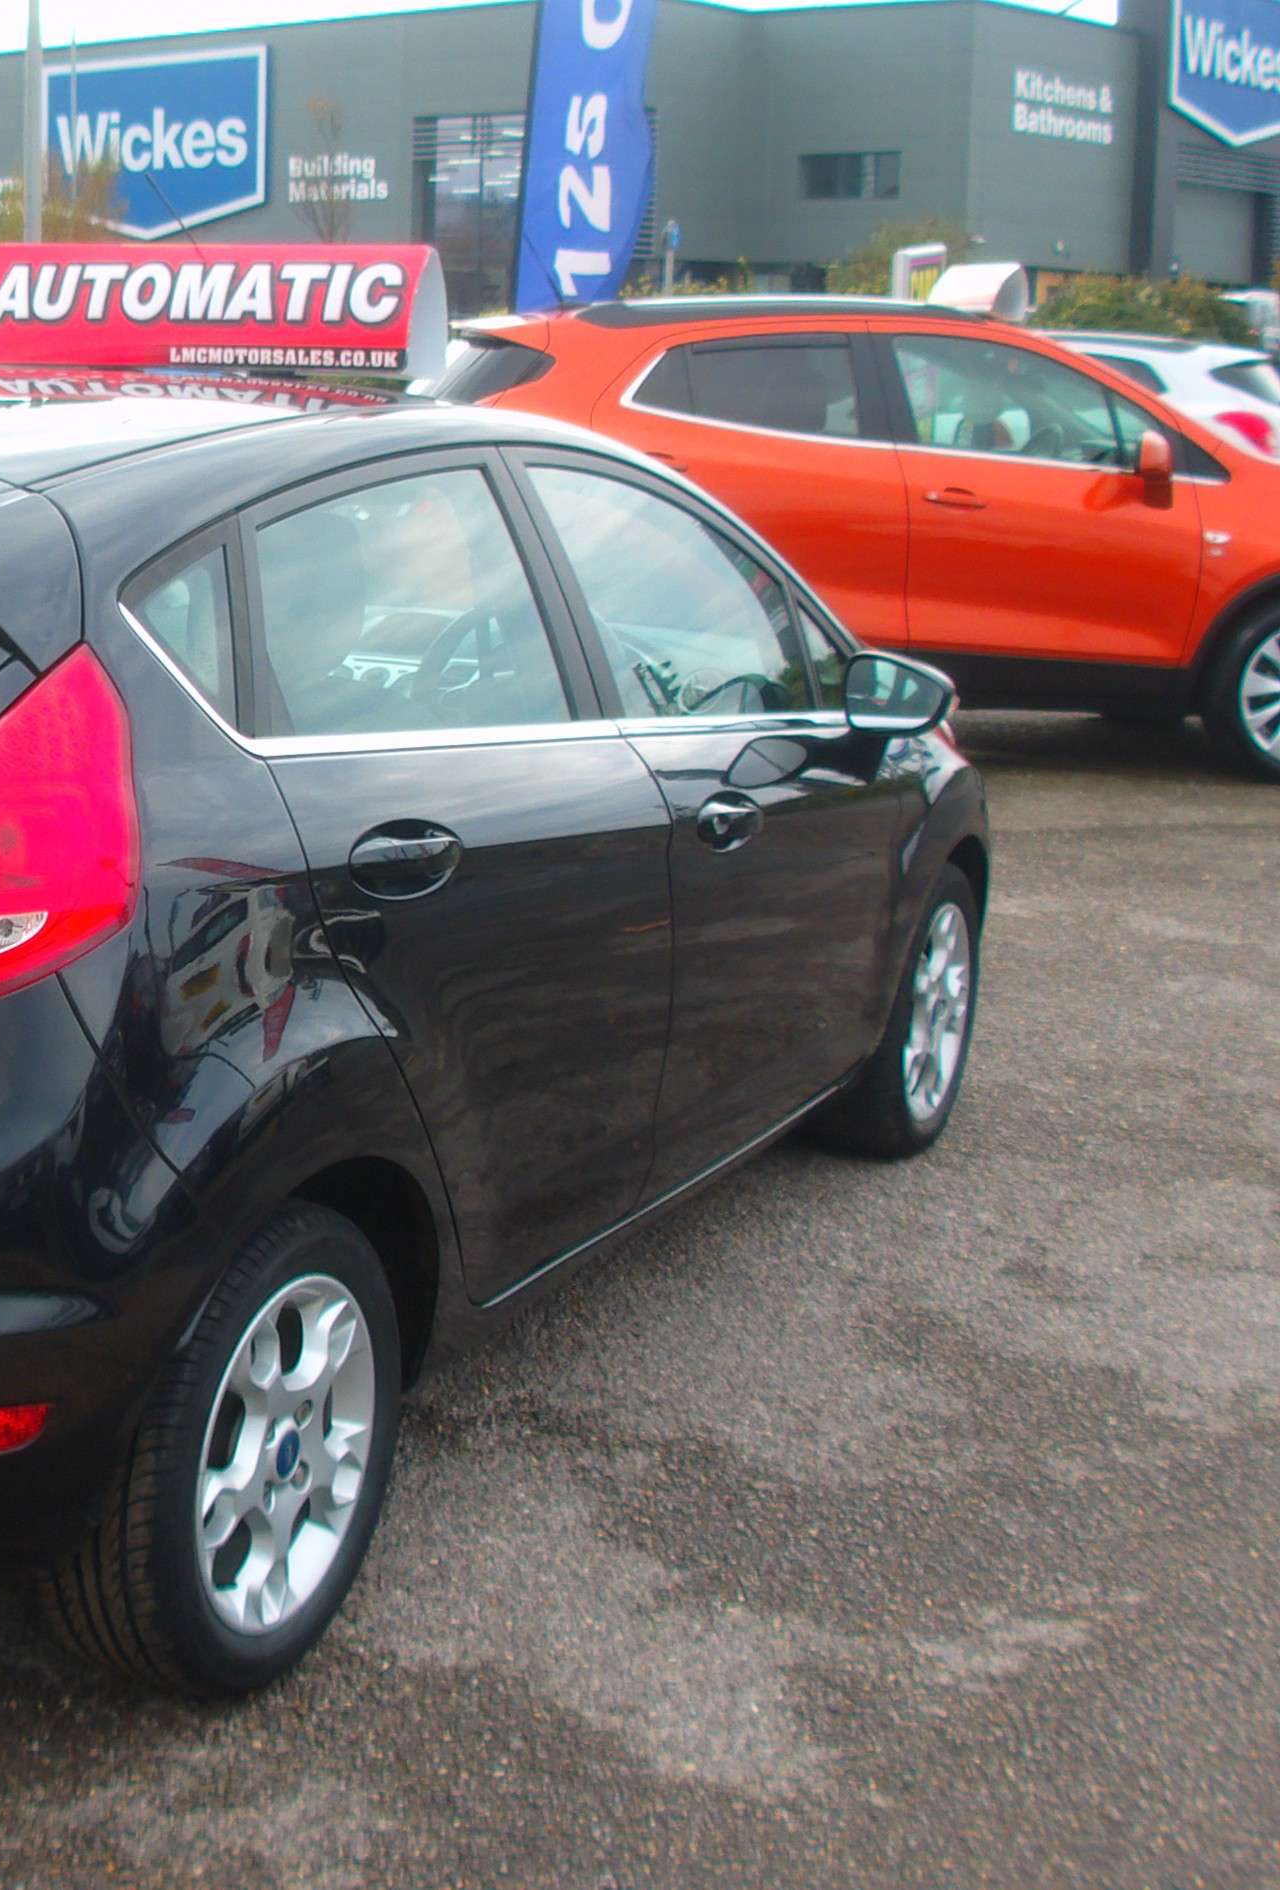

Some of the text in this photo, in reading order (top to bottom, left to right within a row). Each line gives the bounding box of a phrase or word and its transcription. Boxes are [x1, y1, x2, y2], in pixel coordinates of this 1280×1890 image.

[1014, 68, 1113, 114] Kitchens &
[56, 106, 248, 175] Wickes
[1013, 102, 1113, 145] Bathrooms
[288, 152, 376, 178] Building
[288, 178, 389, 203] Materials
[554, 92, 612, 297] 125
[169, 346, 399, 369] LMCMOTORSALES.CO.UK
